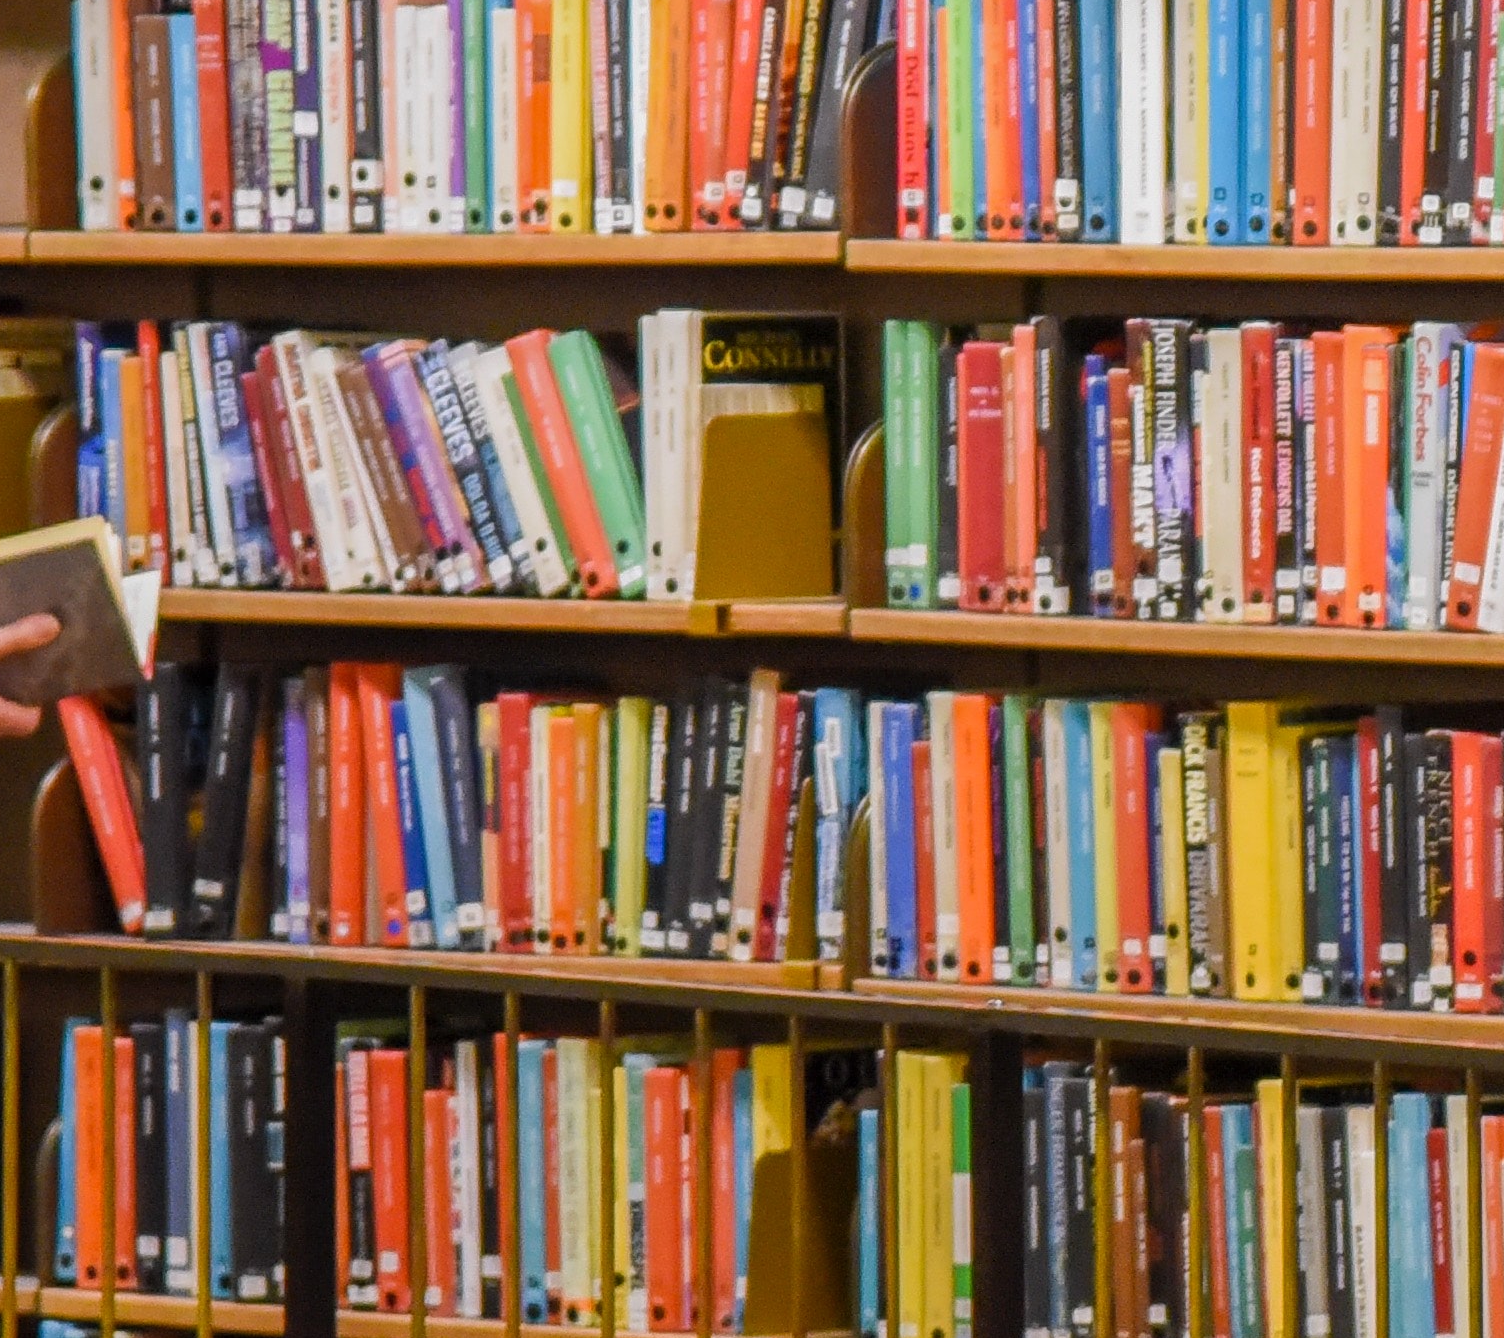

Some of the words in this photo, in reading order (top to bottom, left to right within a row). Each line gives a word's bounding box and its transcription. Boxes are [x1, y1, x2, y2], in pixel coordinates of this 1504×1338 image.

[905, 54, 921, 89] Död
[703, 339, 835, 374] CONNELLY
[1155, 326, 1177, 387] JOSEPH
[1415, 336, 1433, 390] Colin
[426, 368, 472, 463] CLEEVES
[1156, 391, 1176, 450] FINDER
[1276, 378, 1292, 437] FOLLETT
[1415, 391, 1433, 462] Forbes
[1132, 464, 1155, 549] MAKT
[1185, 722, 1207, 759] DICK
[1185, 769, 1207, 845] FRANCIS
